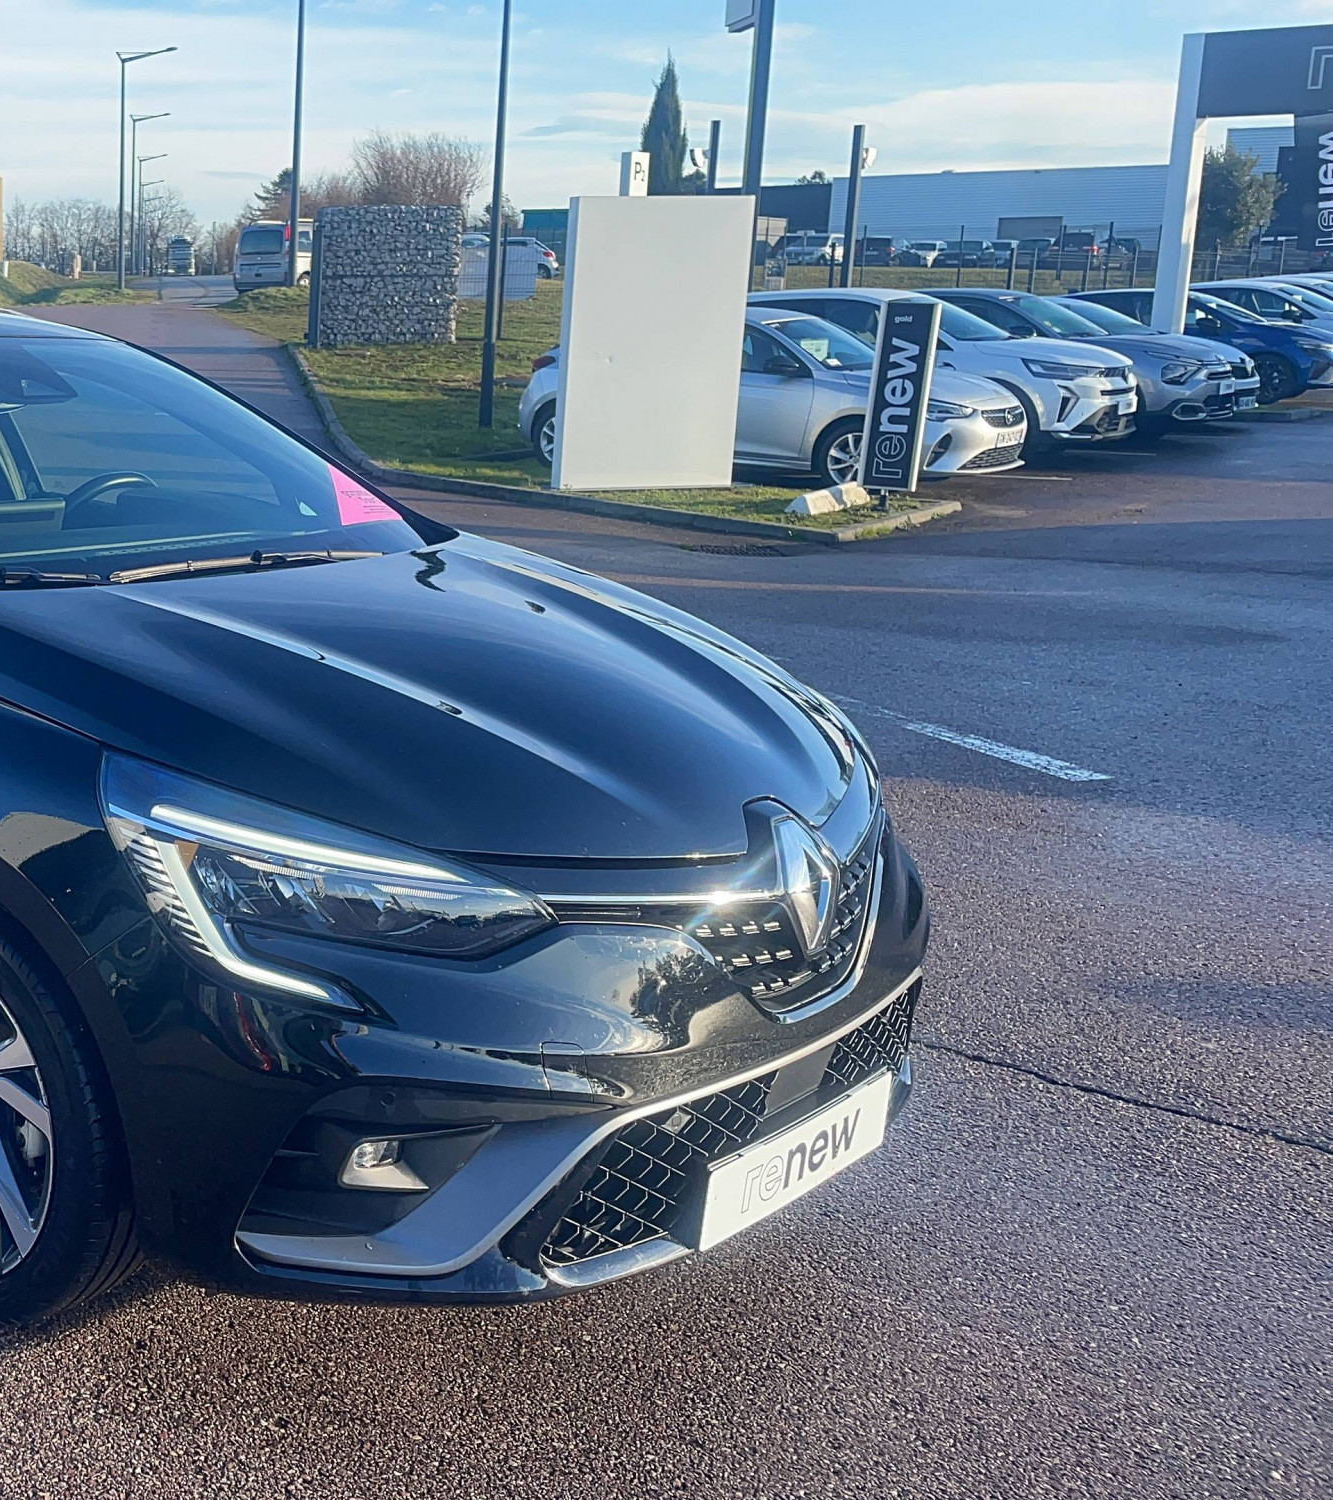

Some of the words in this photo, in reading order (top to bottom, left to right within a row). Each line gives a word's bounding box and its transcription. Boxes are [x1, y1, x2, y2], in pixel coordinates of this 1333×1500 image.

[894, 315, 913, 324] gold
[872, 337, 920, 479] renew
[741, 1107, 862, 1215] renew
